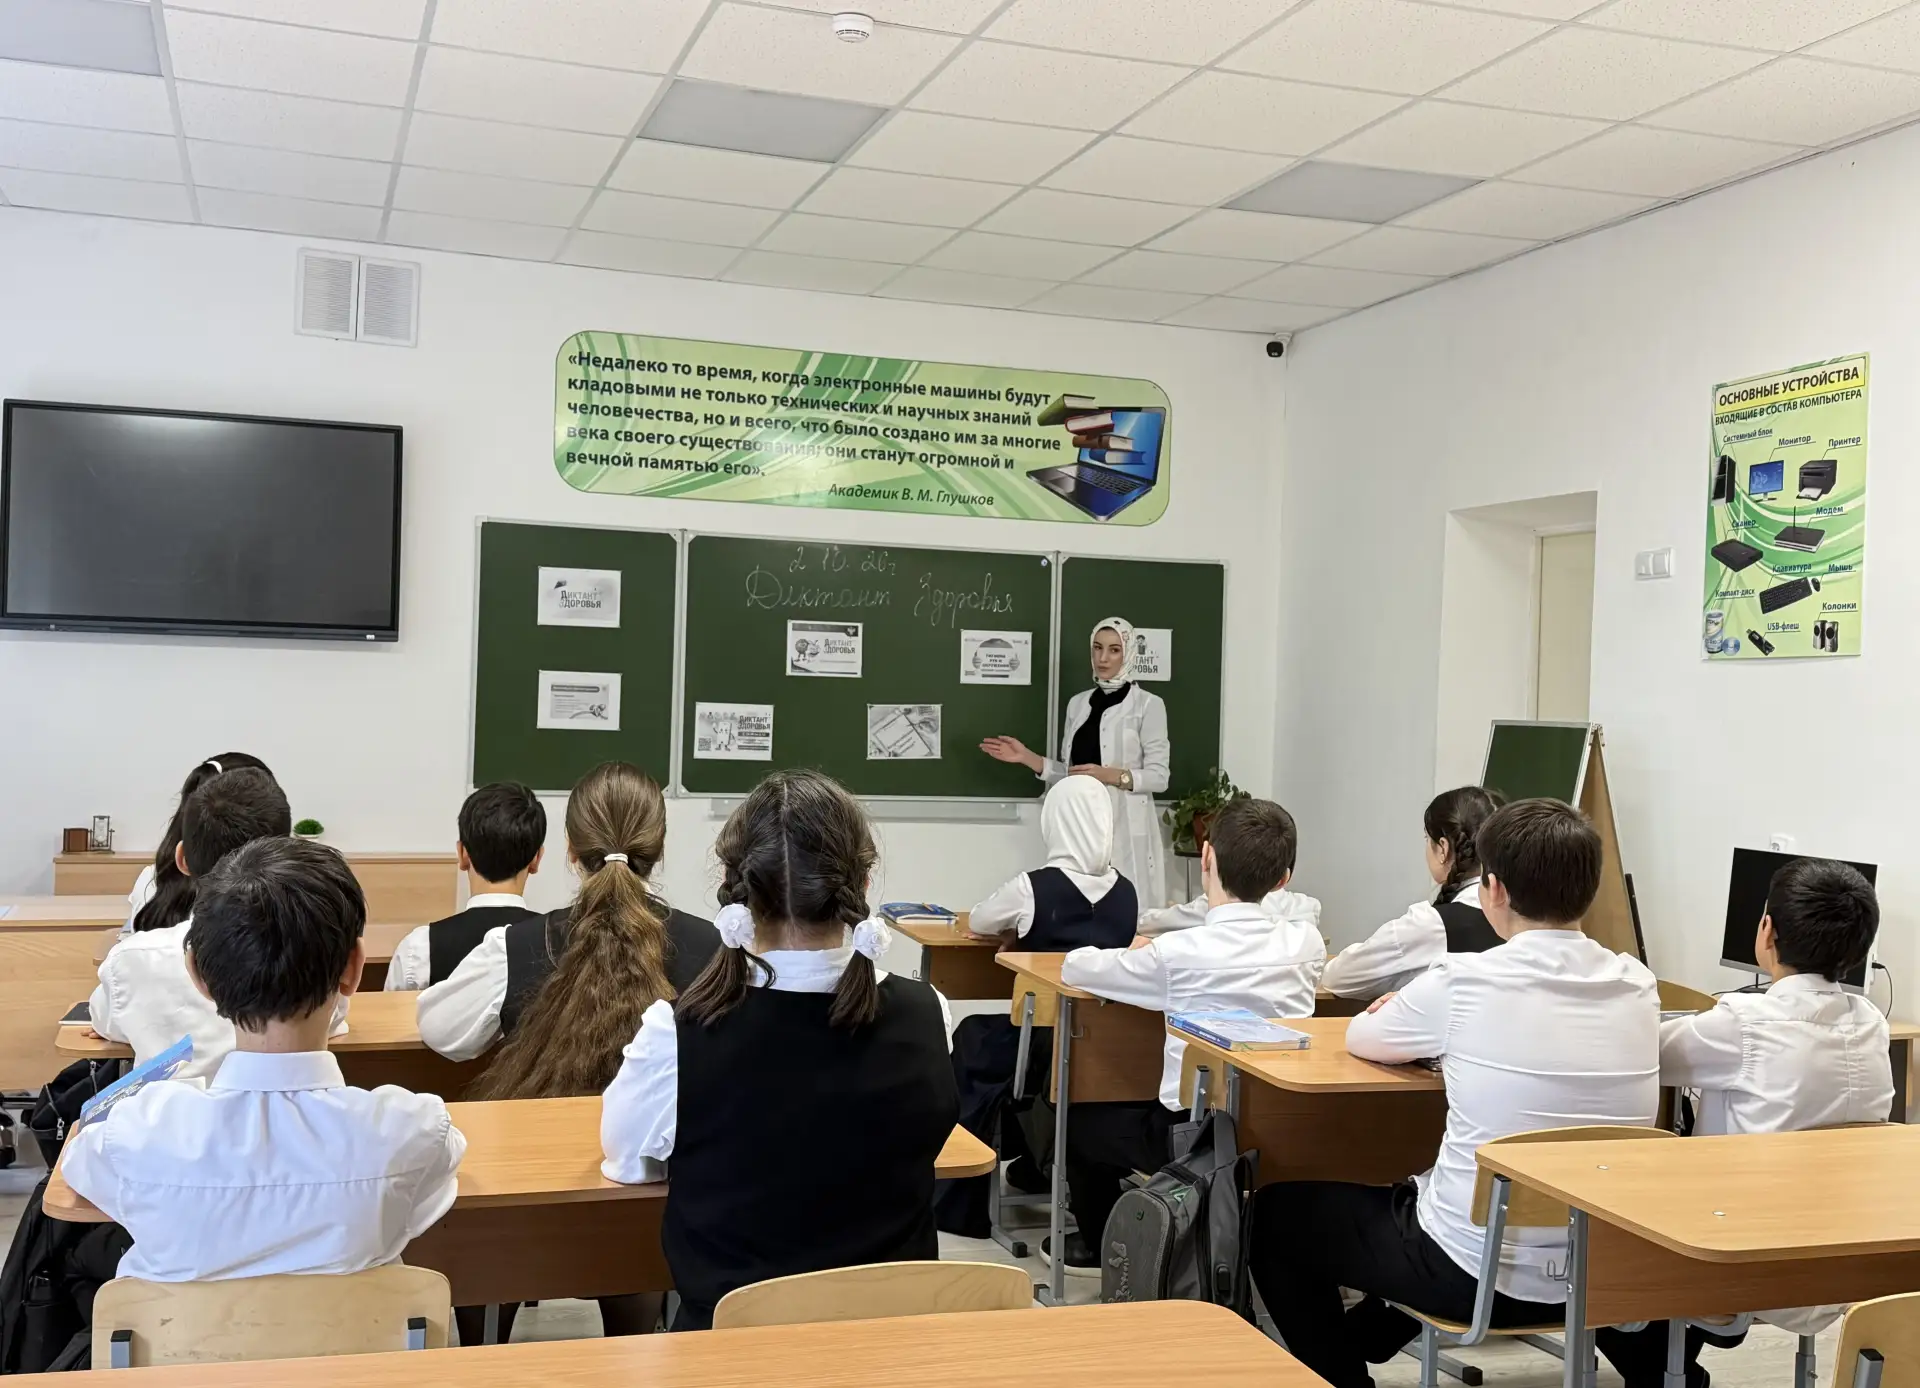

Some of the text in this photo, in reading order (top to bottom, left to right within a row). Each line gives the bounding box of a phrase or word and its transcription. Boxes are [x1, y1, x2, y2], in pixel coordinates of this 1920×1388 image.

[568, 351, 1051, 406] «Недалеко то время, когда электронные машины будут
[1719, 366, 1859, 407] ОСНОВНЫЕ УСТРОЙСТВА
[568, 378, 1031, 426] кладовыми не только технических и научных знаний
[1715, 389, 1862, 426] ВХОДЯЩИЕ В СОСТАВ КОМПЬЮТЕРА
[567, 402, 1061, 450] человечества, но и всего, что было создано им за многие
[1722, 428, 1772, 443] Системный блок
[1778, 435, 1811, 447] Монитор
[1828, 436, 1861, 448] Принтер
[567, 425, 609, 441] века
[614, 429, 674, 445] своего
[824, 445, 857, 458] они
[860, 446, 915, 465] станут
[919, 450, 1000, 469] огромной
[1004, 459, 1014, 469] и
[566, 449, 766, 477] вечной памятью его».
[828, 484, 994, 506] Академик В. М. Глушков
[1816, 506, 1843, 515] Модем
[1732, 519, 1756, 528] Сканер
[1772, 563, 1812, 573] Клавиатура
[1828, 564, 1853, 572] Мышь
[745, 563, 891, 610] Диктант
[1715, 588, 1755, 598] Компакт-диск
[1822, 602, 1857, 611] Колонки
[1768, 622, 1799, 631] USB-флеш
